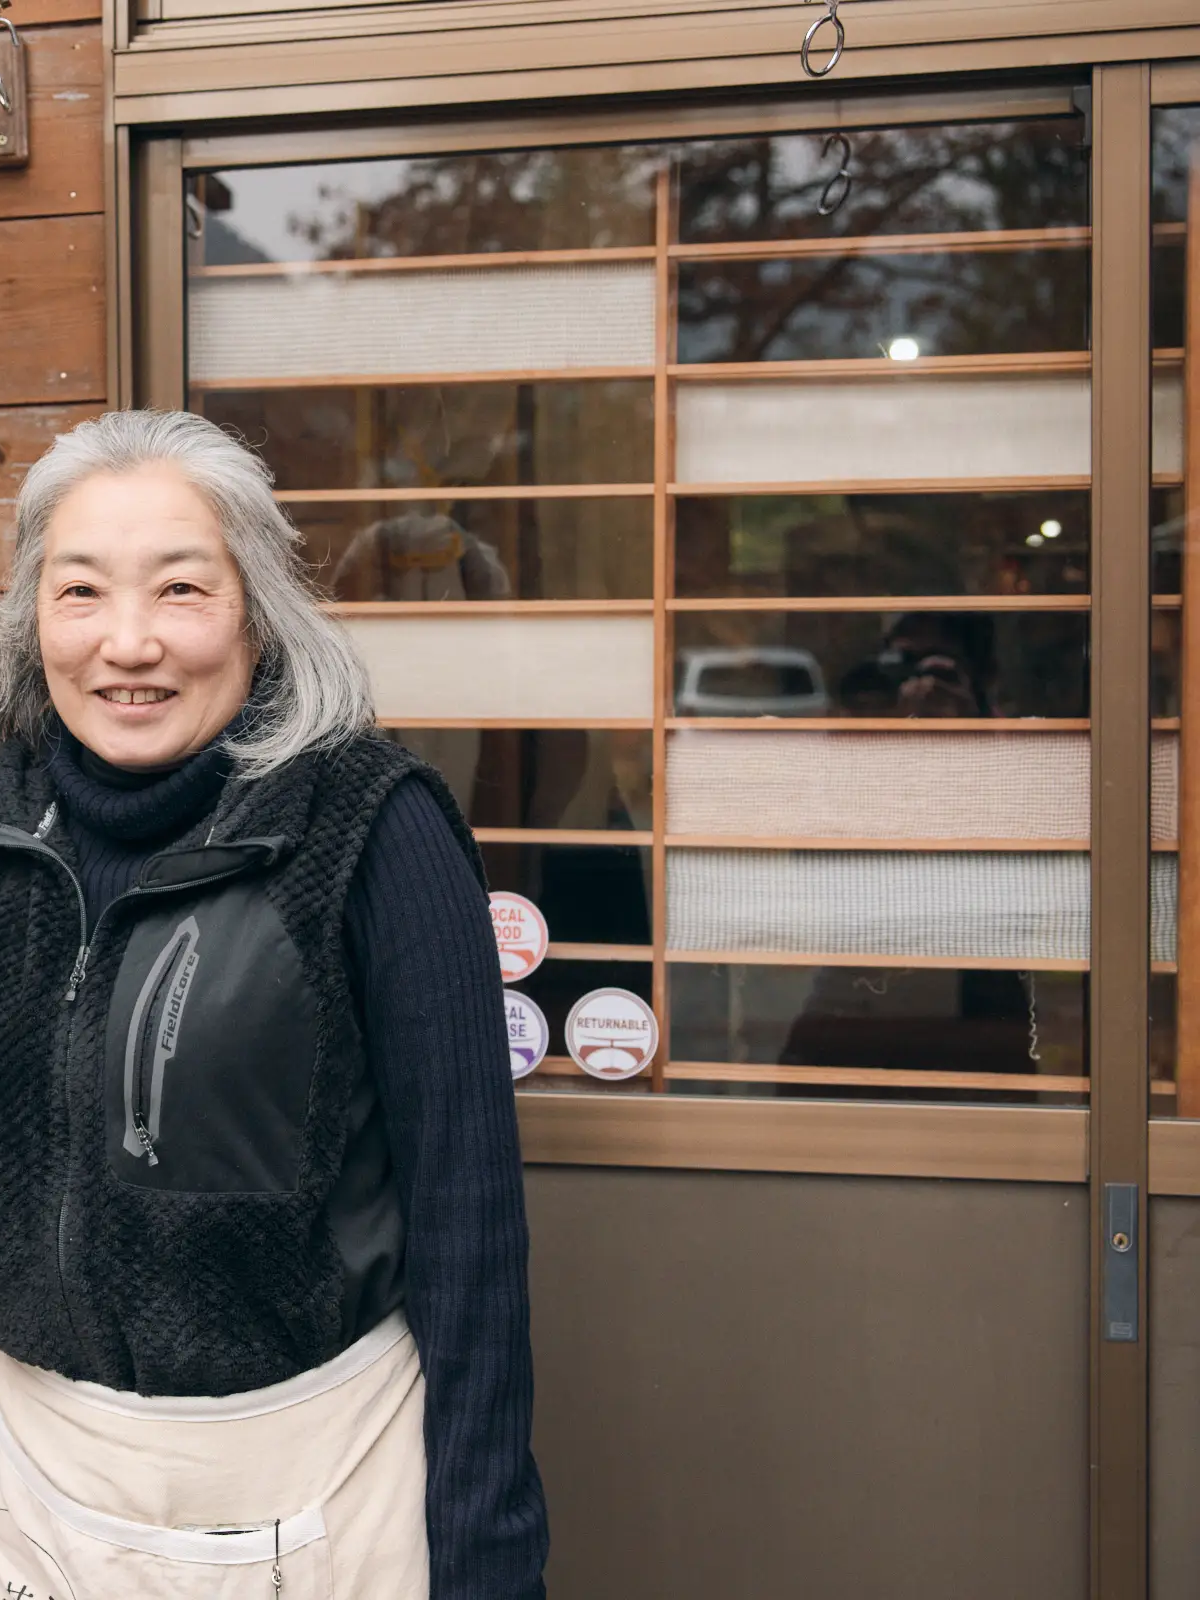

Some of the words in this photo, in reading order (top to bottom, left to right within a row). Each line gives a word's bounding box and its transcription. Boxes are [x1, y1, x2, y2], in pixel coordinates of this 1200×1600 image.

[490, 908, 524, 923] OCAL
[494, 926, 522, 940] OOD
[161, 955, 196, 1052] FieldCore
[577, 1016, 649, 1032] RETURNABLE
